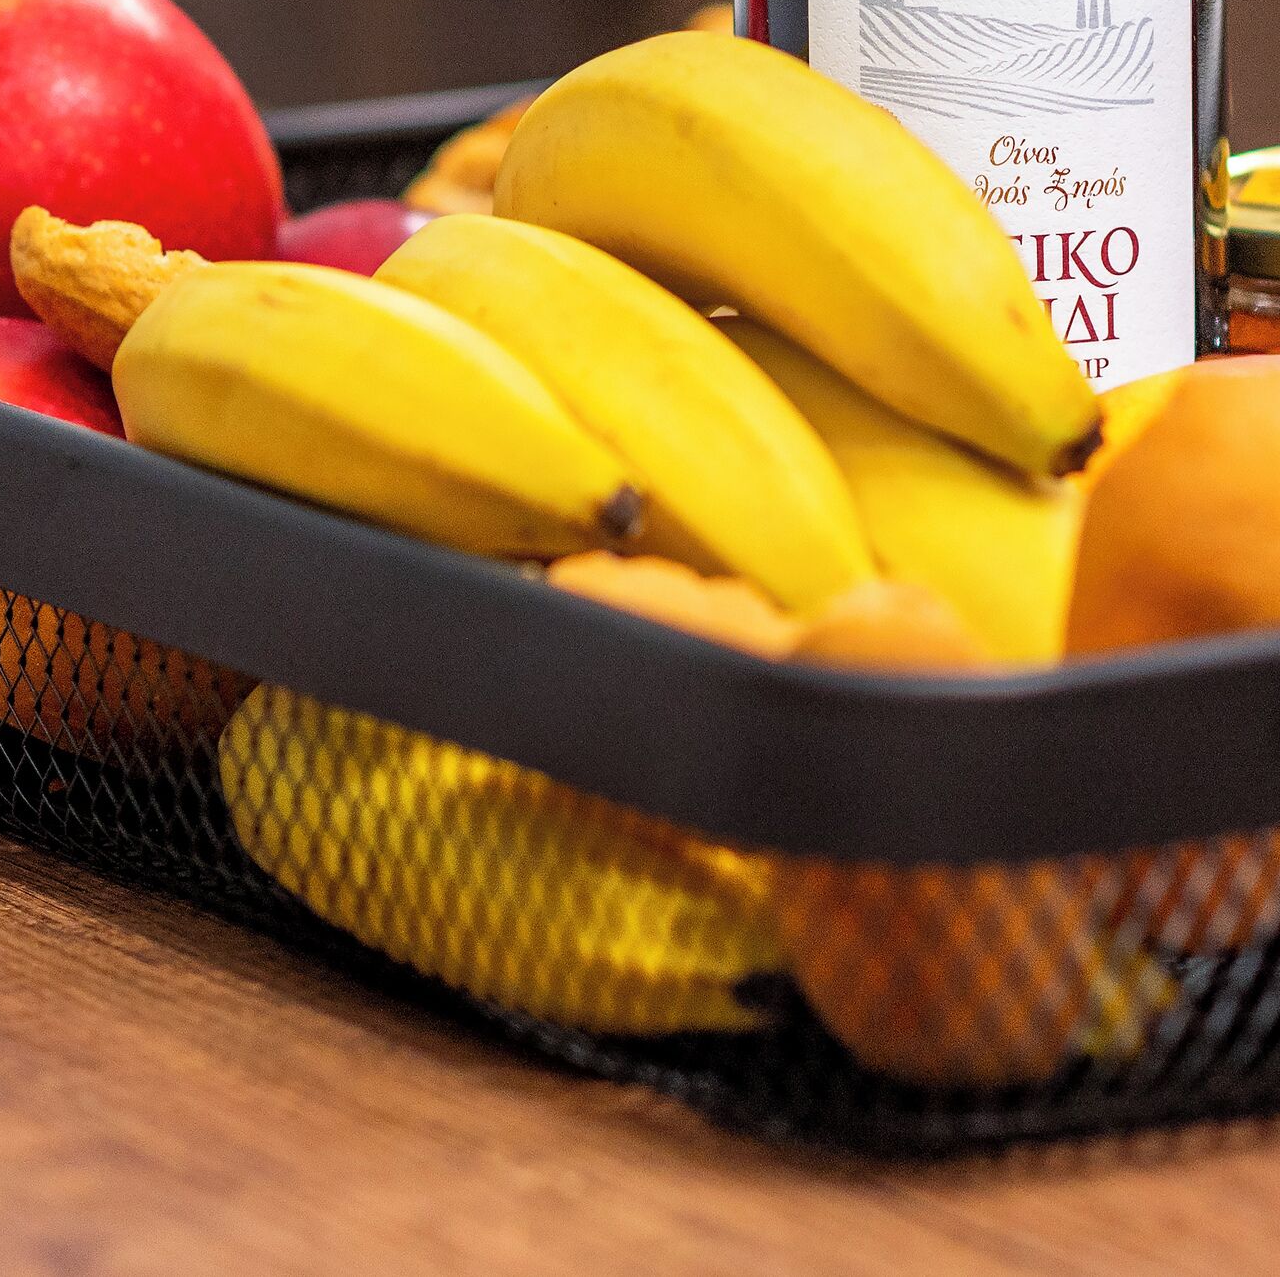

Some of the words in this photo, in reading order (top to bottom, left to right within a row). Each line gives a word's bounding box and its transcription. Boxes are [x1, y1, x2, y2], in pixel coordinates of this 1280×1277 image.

[989, 135, 1060, 166] Οίνος
[974, 174, 1031, 211] θρός
[1043, 167, 1127, 212] Ξηρός
